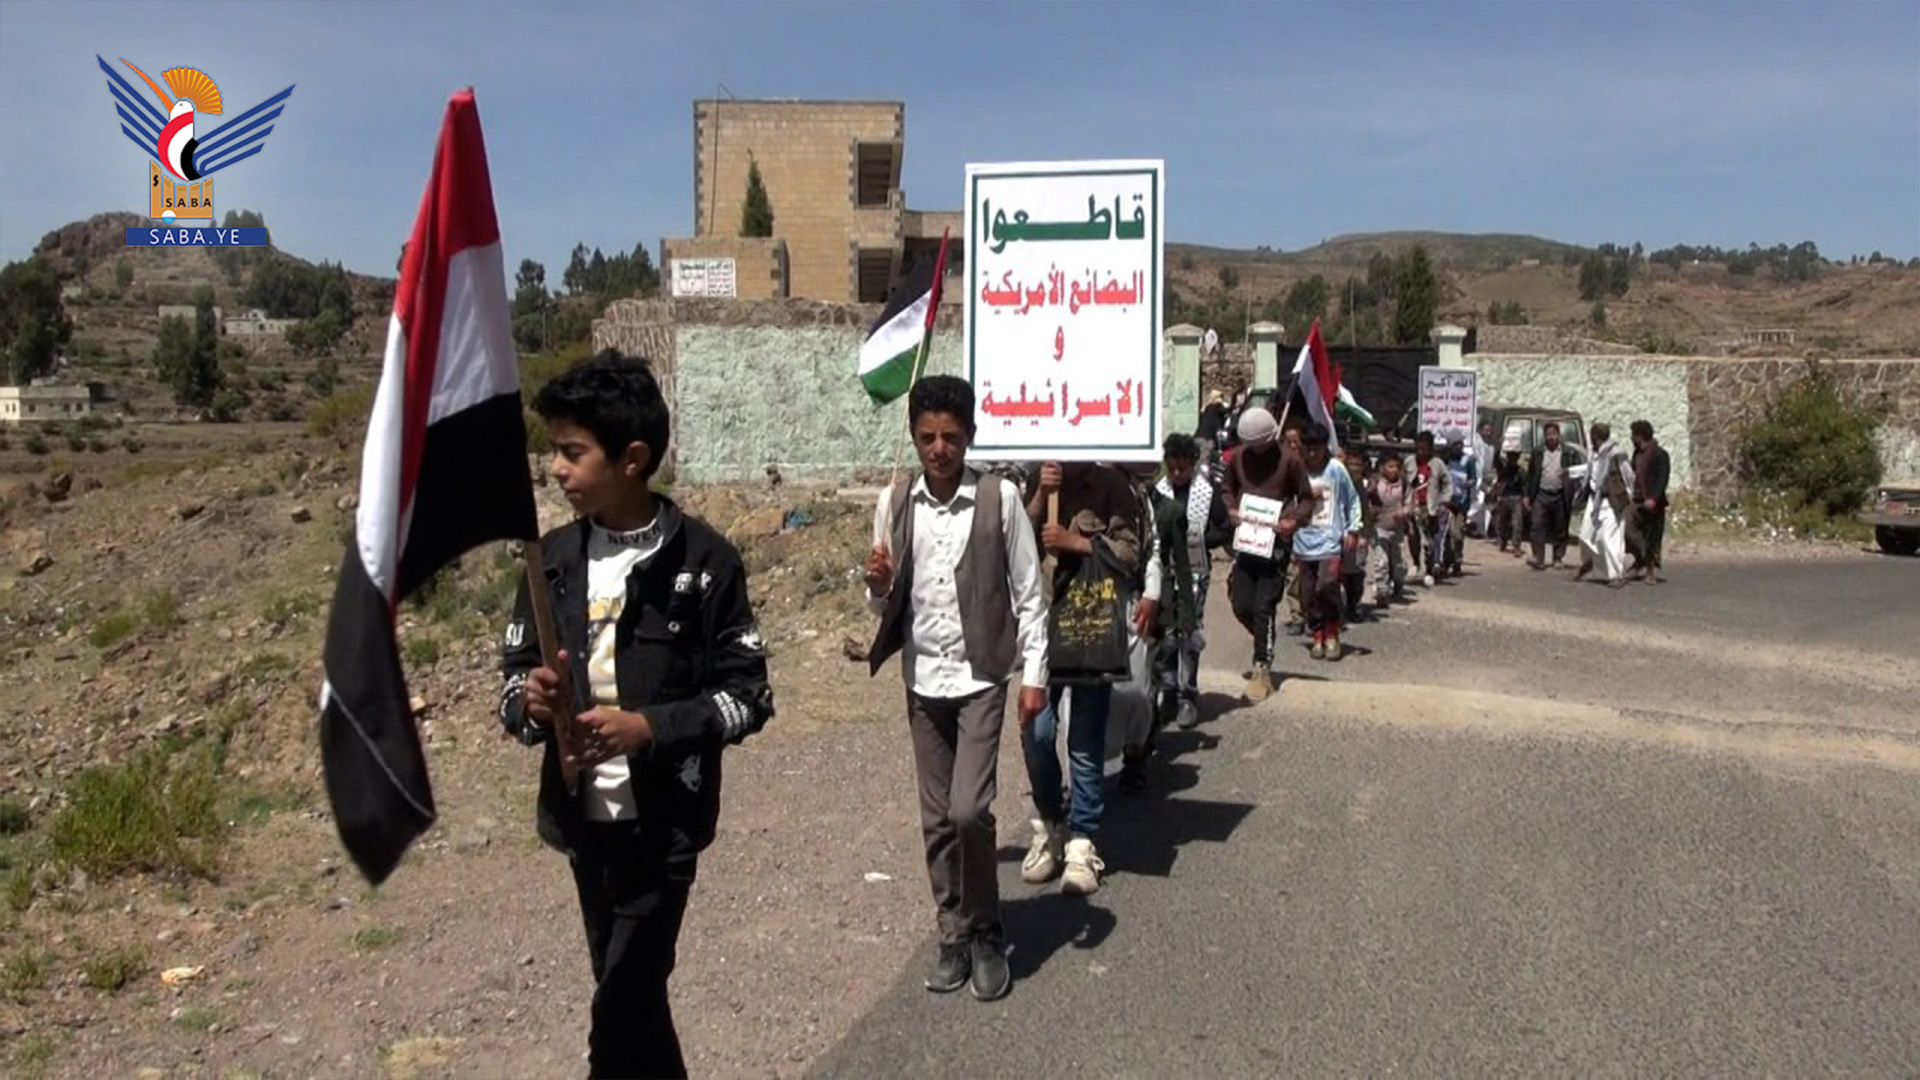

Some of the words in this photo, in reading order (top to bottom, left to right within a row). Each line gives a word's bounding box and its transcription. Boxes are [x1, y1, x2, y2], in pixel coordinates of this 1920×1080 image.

[982, 194, 1145, 254] قاطعوا
[982, 263, 1065, 316] الأمريكية
[1069, 268, 1144, 315] البضائع
[1053, 325, 1065, 362] و
[607, 524, 661, 546] NEVER
